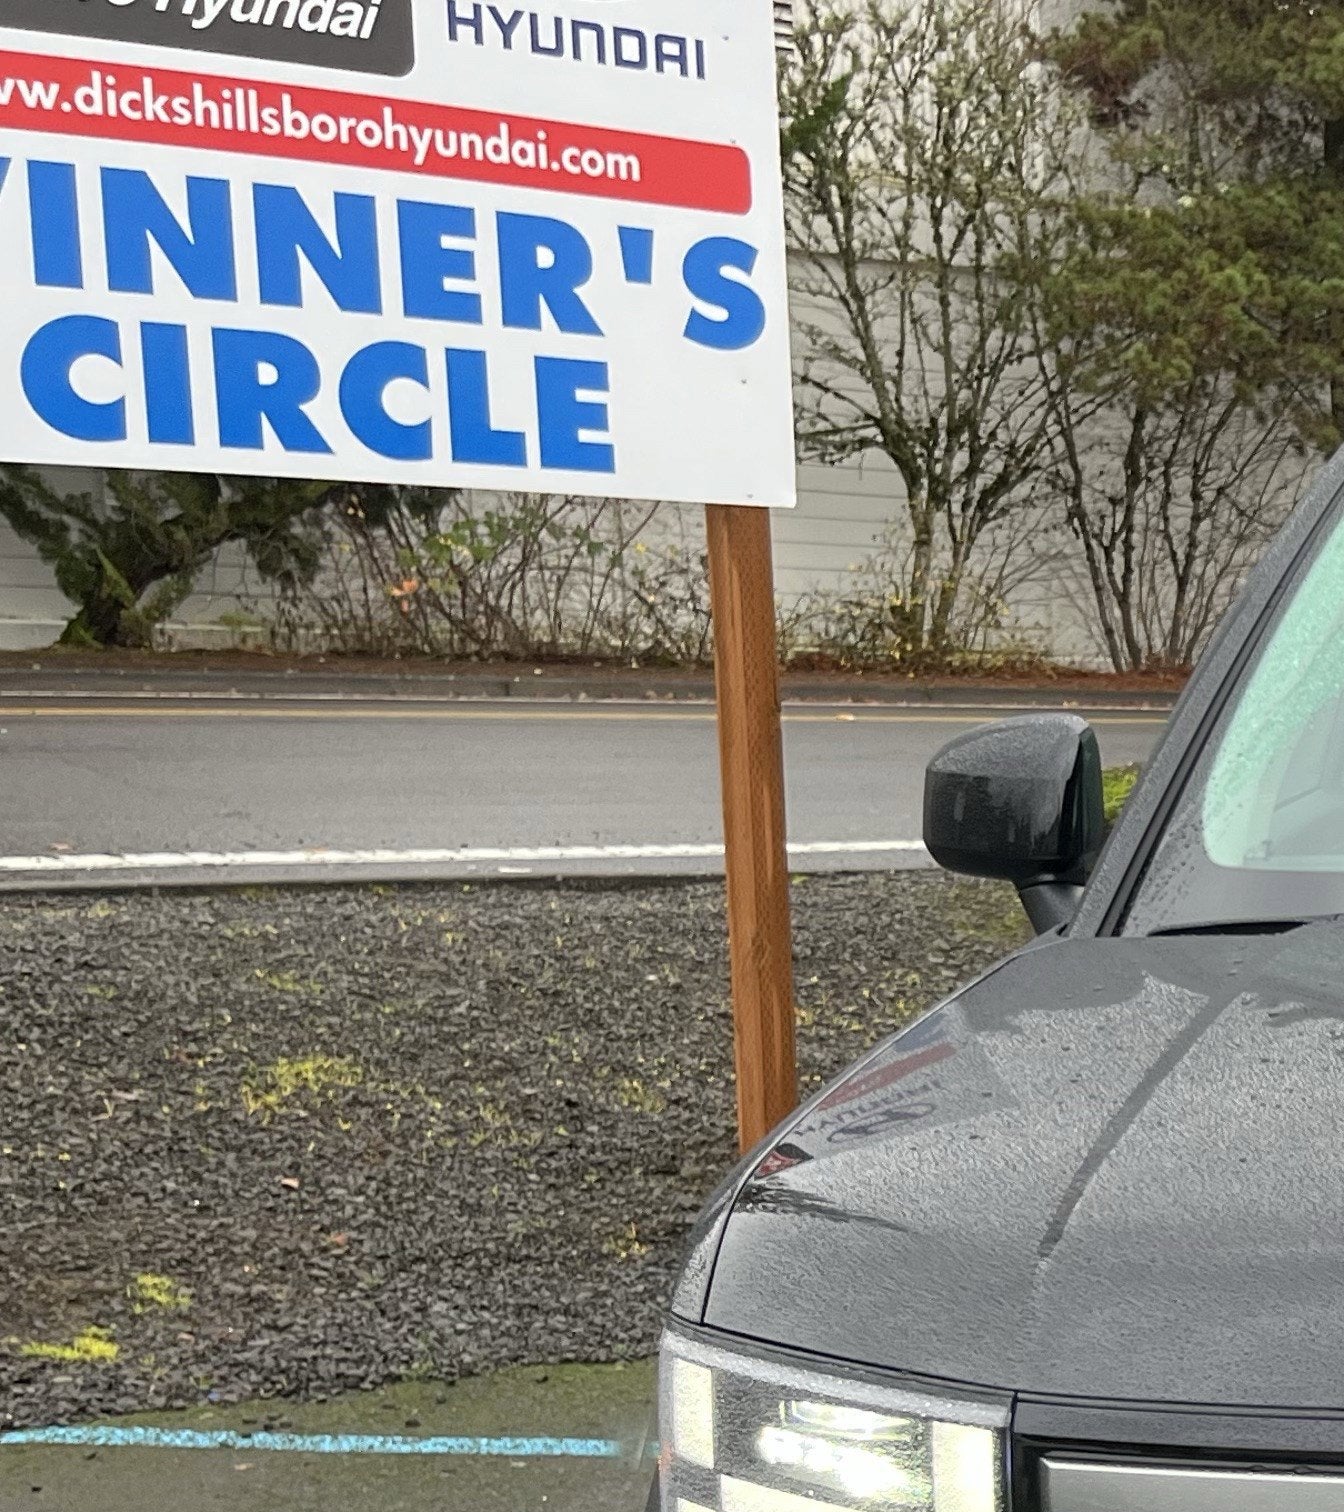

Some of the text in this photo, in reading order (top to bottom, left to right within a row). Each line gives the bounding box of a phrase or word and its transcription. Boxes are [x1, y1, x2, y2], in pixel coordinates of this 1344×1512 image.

[155, 0, 380, 39] yundai
[447, 0, 706, 81] HYUNDAI
[0, 156, 767, 351] INNER'S
[20, 314, 617, 474] CIRCLE
